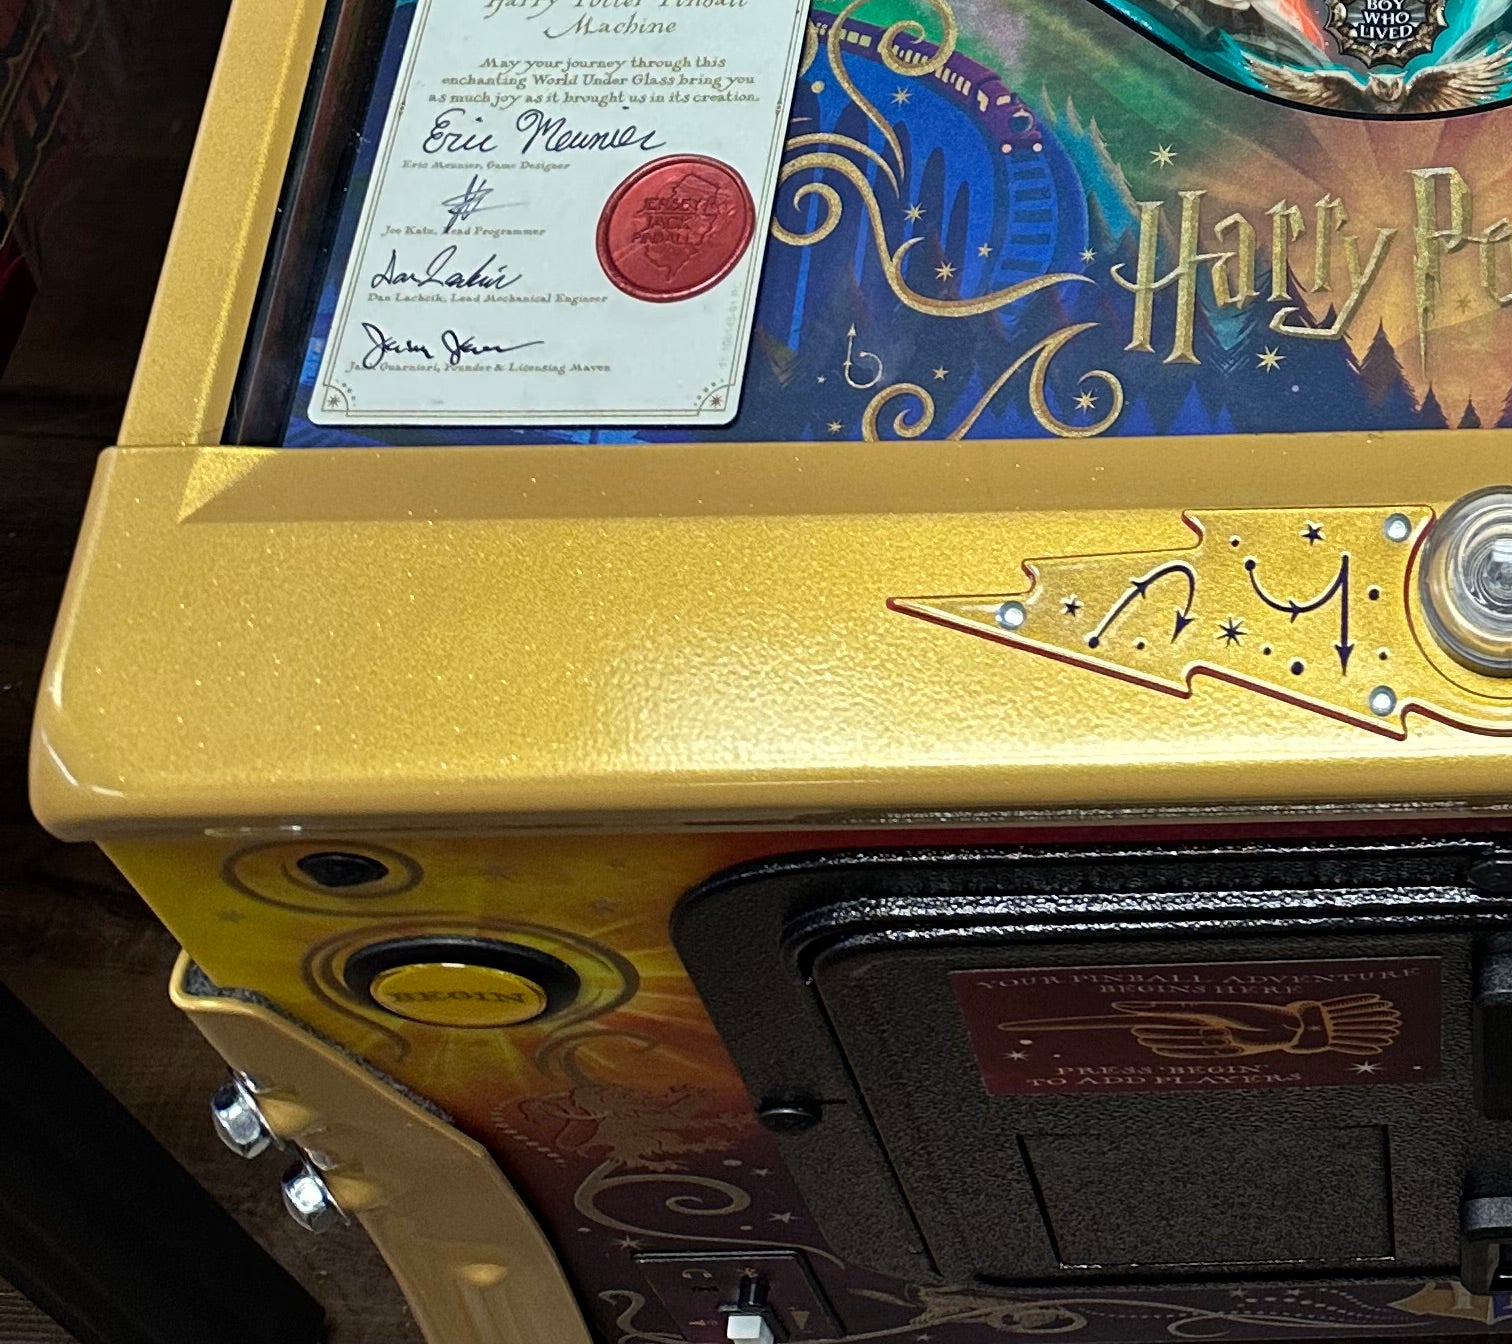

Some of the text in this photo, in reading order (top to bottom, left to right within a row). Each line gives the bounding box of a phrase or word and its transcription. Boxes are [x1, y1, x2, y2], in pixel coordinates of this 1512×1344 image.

[543, 11, 678, 40] Machine
[1363, 11, 1410, 26] WHO
[1360, 24, 1413, 40] LIVED
[479, 56, 726, 75] May your journey through this
[441, 73, 755, 92] enchanting World Under Glass bring you
[428, 90, 760, 110] as much joy as it brought us in its creation.
[422, 107, 499, 154] Eric
[401, 160, 428, 170] Eric
[519, 160, 571, 172] Designer
[472, 225, 547, 238] Programmer
[1111, 190, 1399, 365] Harry
[367, 293, 391, 303] Dan
[450, 293, 481, 303] Lead
[483, 292, 552, 303] Mechanical
[975, 967, 1422, 990] YOUR PINBALL ADVENTURE
[1098, 983, 1304, 995] BEGINS HERE
[386, 990, 526, 1005] BEGIN
[1056, 1063, 1154, 1076] PRESS
[1025, 1072, 1304, 1087] TO ADD PLAYERS
